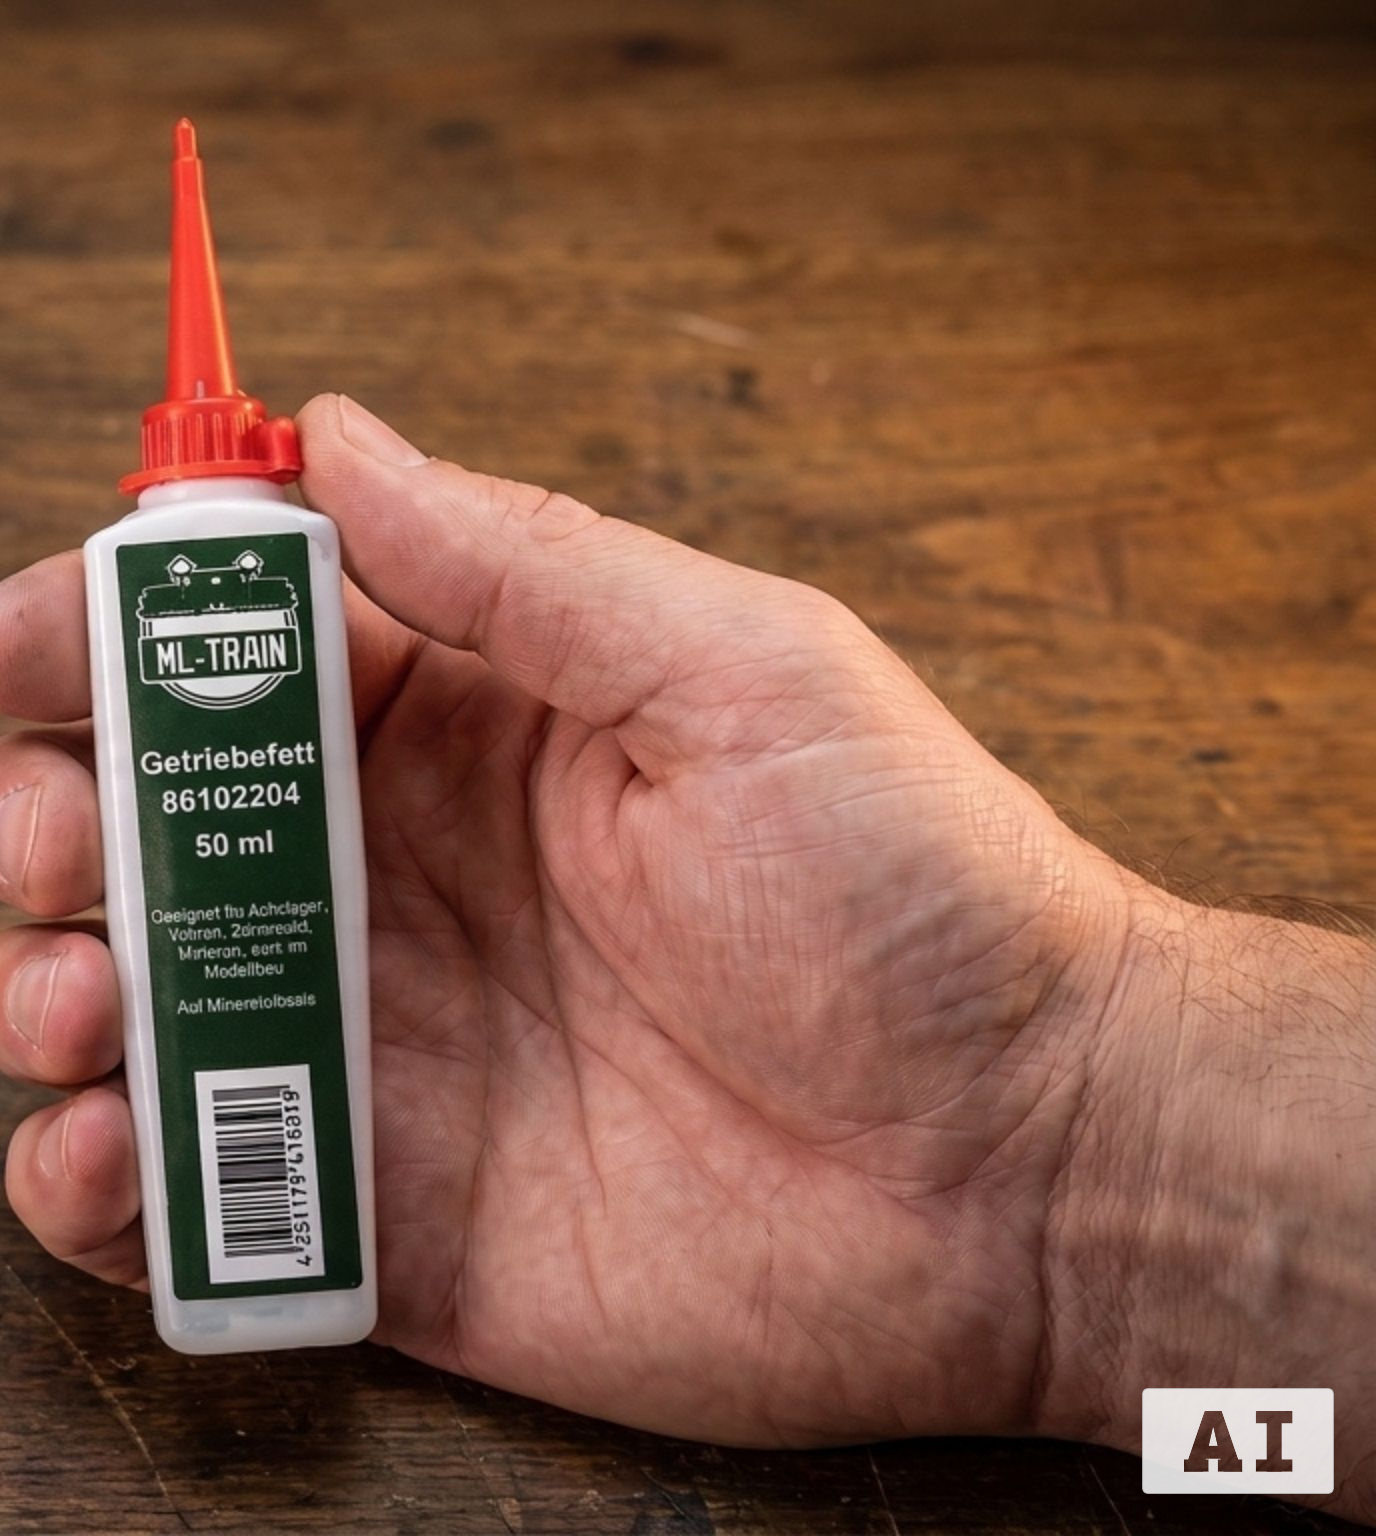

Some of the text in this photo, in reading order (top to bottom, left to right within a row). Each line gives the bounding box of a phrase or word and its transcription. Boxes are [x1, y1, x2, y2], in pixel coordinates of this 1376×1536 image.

[156, 633, 287, 675] ML-TRAIN
[140, 741, 316, 776] Getriebefett
[162, 781, 301, 814] 86102204
[195, 829, 274, 858] 50 ml
